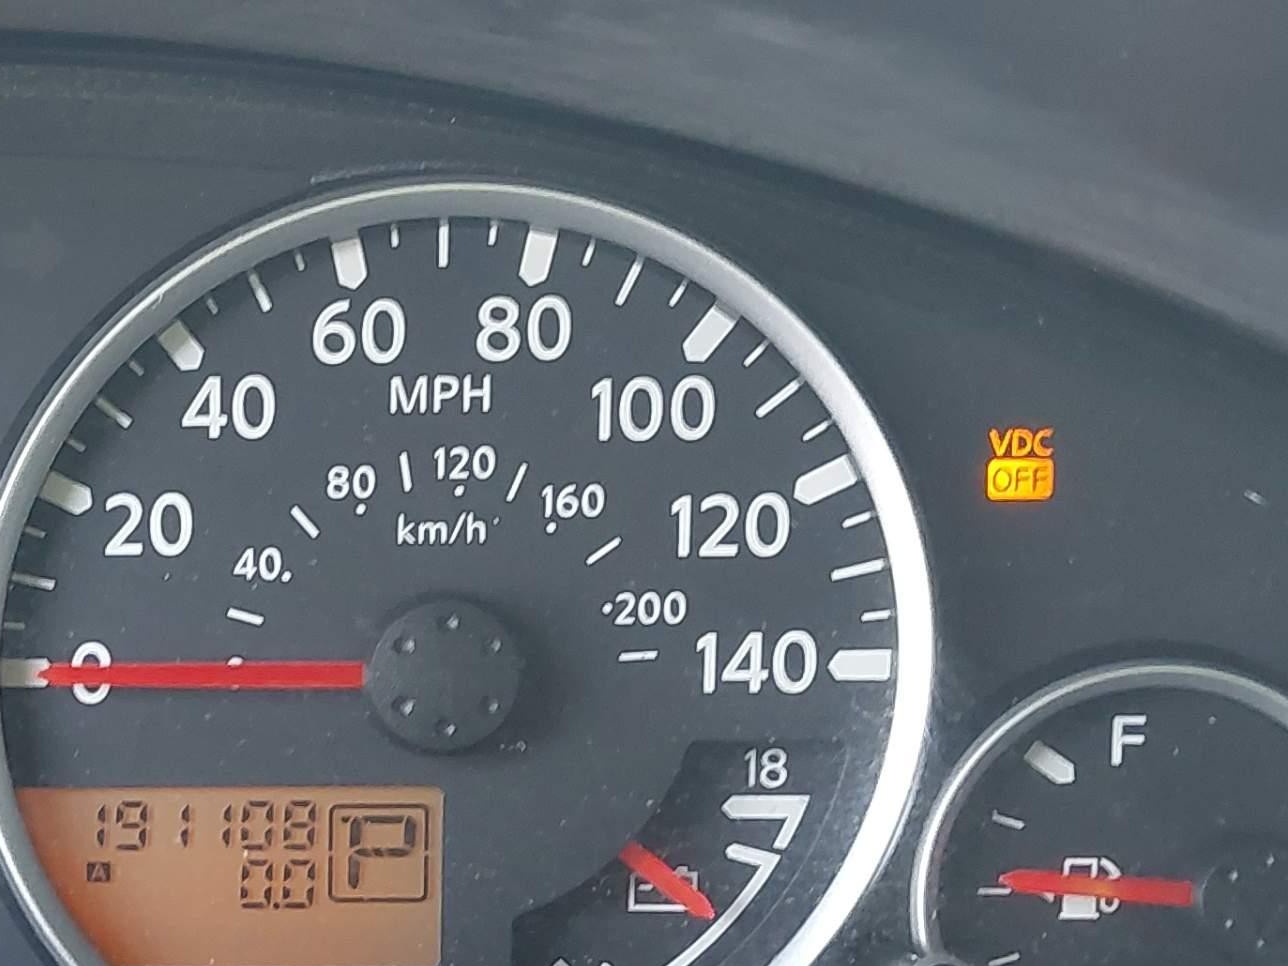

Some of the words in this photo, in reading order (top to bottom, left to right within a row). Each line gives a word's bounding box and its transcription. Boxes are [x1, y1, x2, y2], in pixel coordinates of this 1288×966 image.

[312, 297, 406, 364] 60
[475, 295, 572, 361] 80
[181, 374, 276, 439] 40
[389, 374, 492, 414] MPH
[591, 374, 716, 442] 100
[433, 446, 496, 481] 120
[988, 428, 1054, 456] VDC
[326, 465, 376, 499] 80
[541, 483, 605, 518] 160
[992, 468, 1049, 493] OFF
[104, 492, 194, 557] 20
[396, 513, 487, 545] km/h
[670, 492, 791, 558] 120
[614, 591, 688, 625] 200
[71, 640, 112, 706] 0
[695, 630, 818, 694] 140
[1112, 716, 1147, 767] F
[745, 749, 788, 789] 18
[96, 800, 316, 851] 191108
[341, 814, 418, 890] P
[240, 859, 316, 910] 0.0
